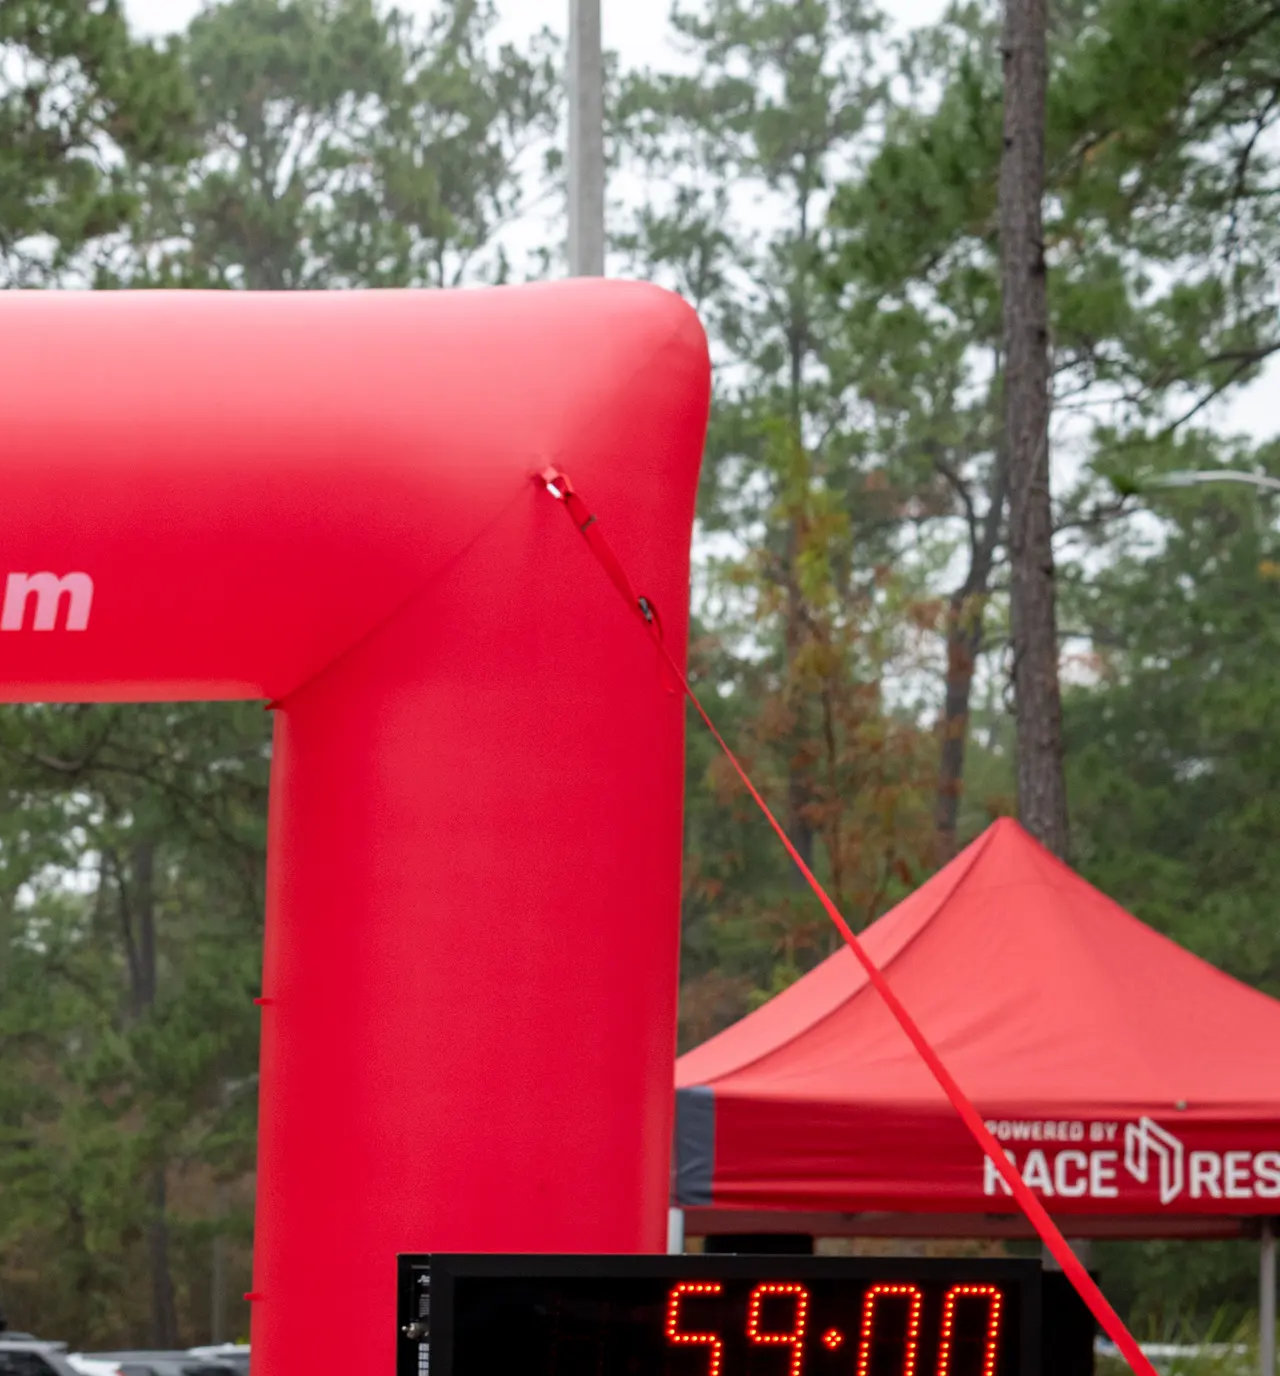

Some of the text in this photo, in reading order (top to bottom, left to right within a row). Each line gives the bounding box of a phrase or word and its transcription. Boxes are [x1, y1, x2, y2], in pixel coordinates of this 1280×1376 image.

[984, 1120, 1119, 1142] POWERED BY
[983, 1149, 1119, 1198] RACE
